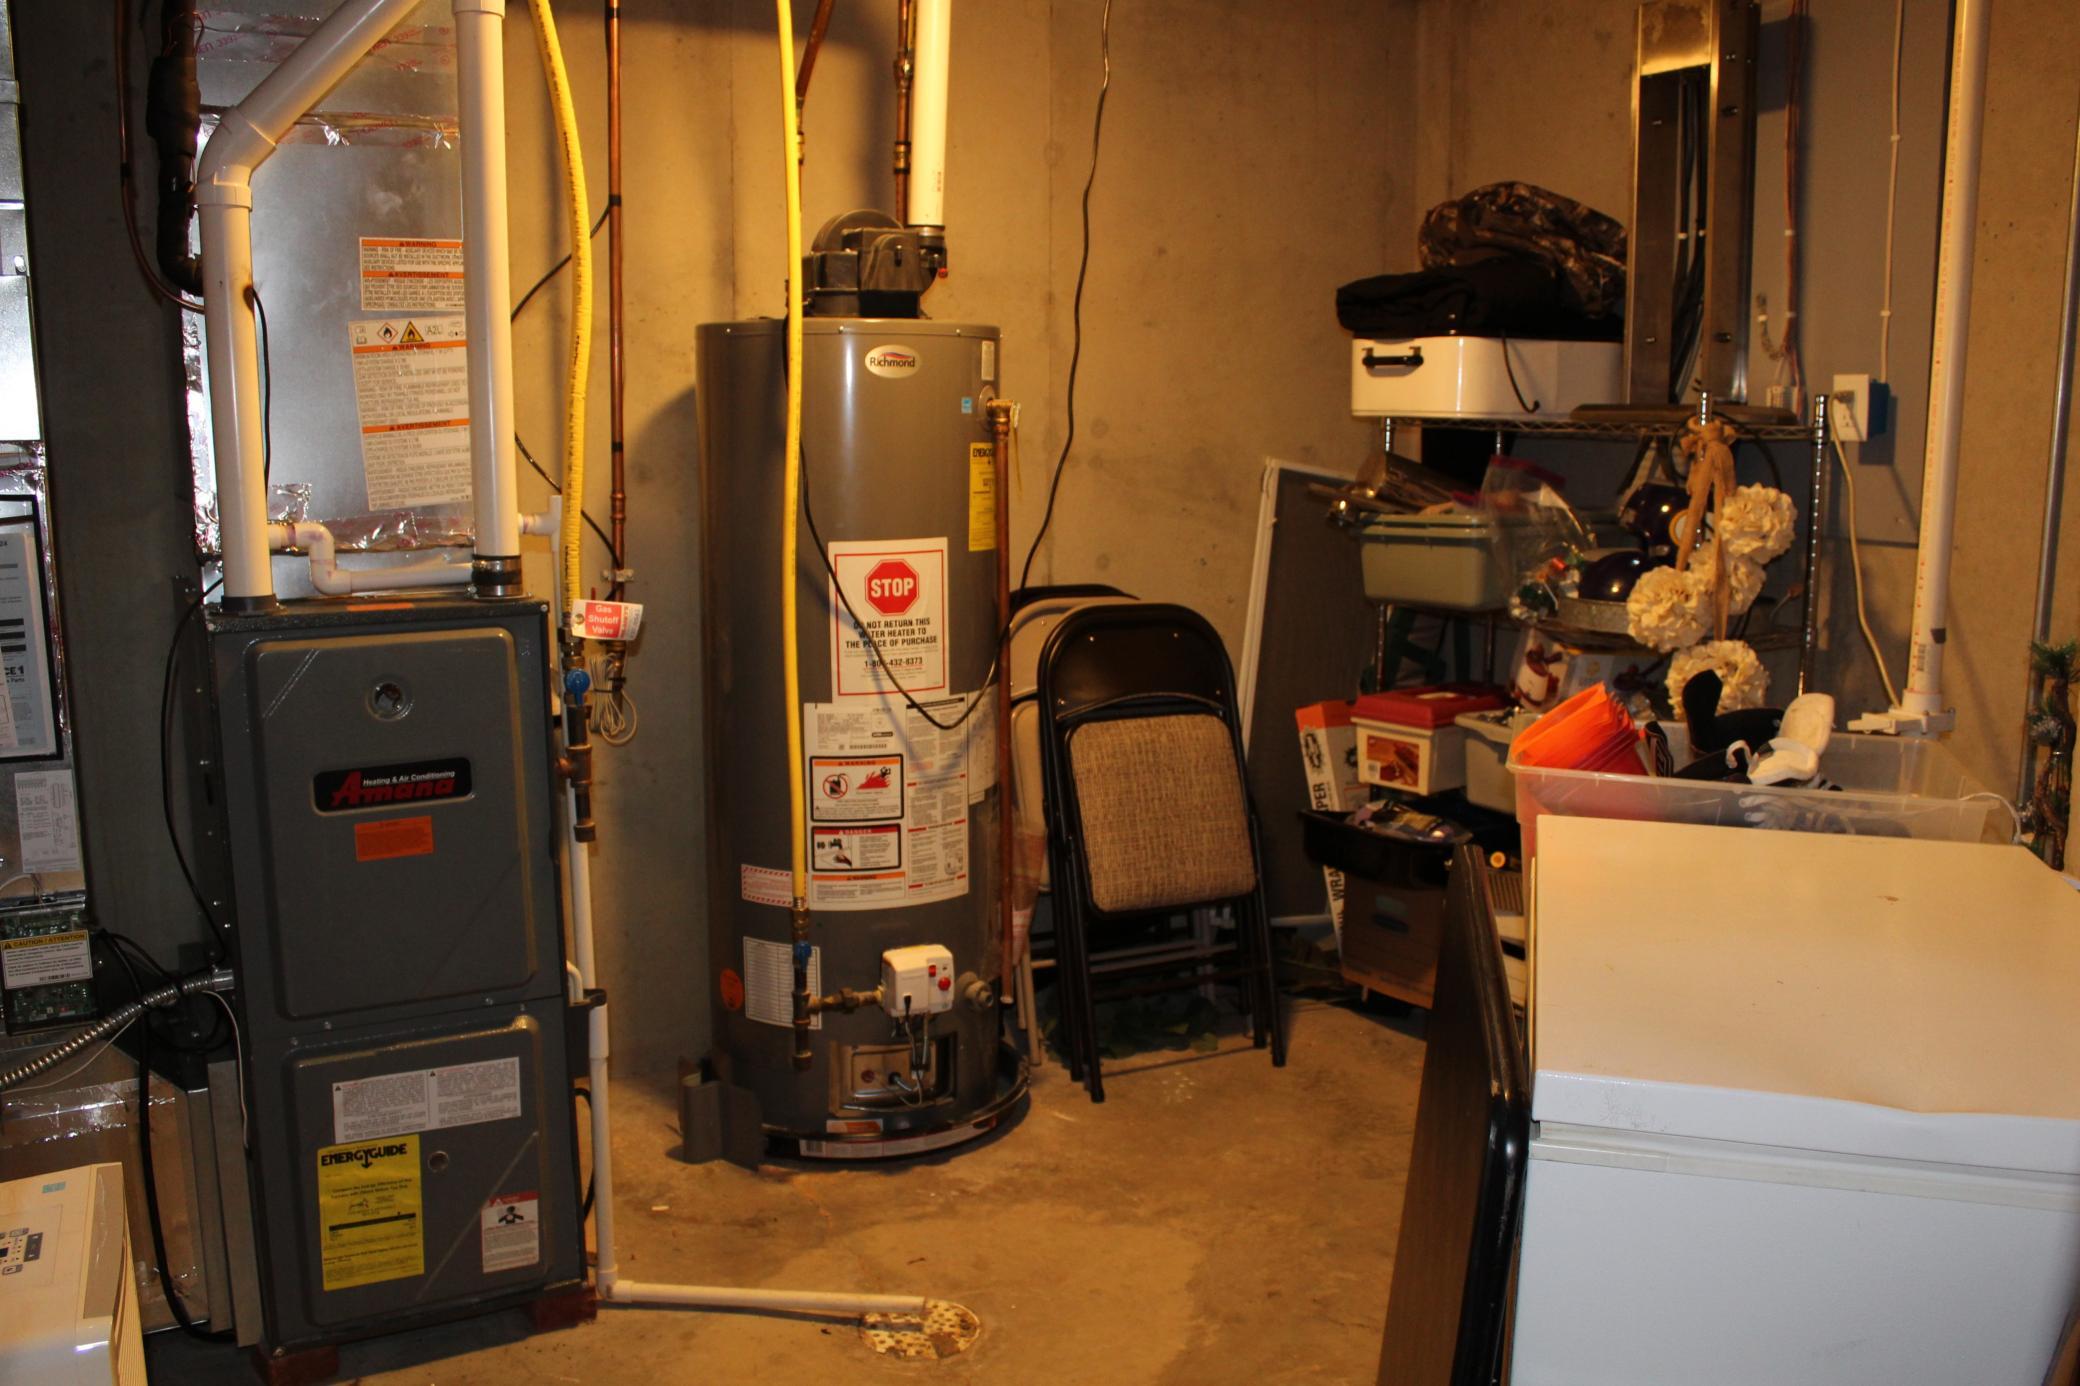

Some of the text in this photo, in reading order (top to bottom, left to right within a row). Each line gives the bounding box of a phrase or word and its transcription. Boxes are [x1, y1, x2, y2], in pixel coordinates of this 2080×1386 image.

[870, 356, 915, 368] Richmond
[870, 577, 914, 598] STOP
[595, 605, 612, 613] Gas
[588, 614, 619, 625] Shutoff
[866, 620, 881, 629] NOT
[883, 619, 913, 628] RETURN
[915, 617, 930, 626] THIS
[591, 625, 614, 634] Valve
[859, 627, 927, 639] WTER HEATER TO
[846, 640, 860, 648] THE
[889, 639, 899, 647] OF
[901, 635, 937, 645] PURCHASE
[865, 656, 923, 668] 1-80-432-8373
[363, 770, 456, 787] Heating & Air Conditioning
[330, 770, 457, 807] Amana
[13, 939, 43, 947] CAUTION
[48, 934, 85, 943] ATTENTION
[321, 1143, 407, 1168] ENERGYGUIDE
